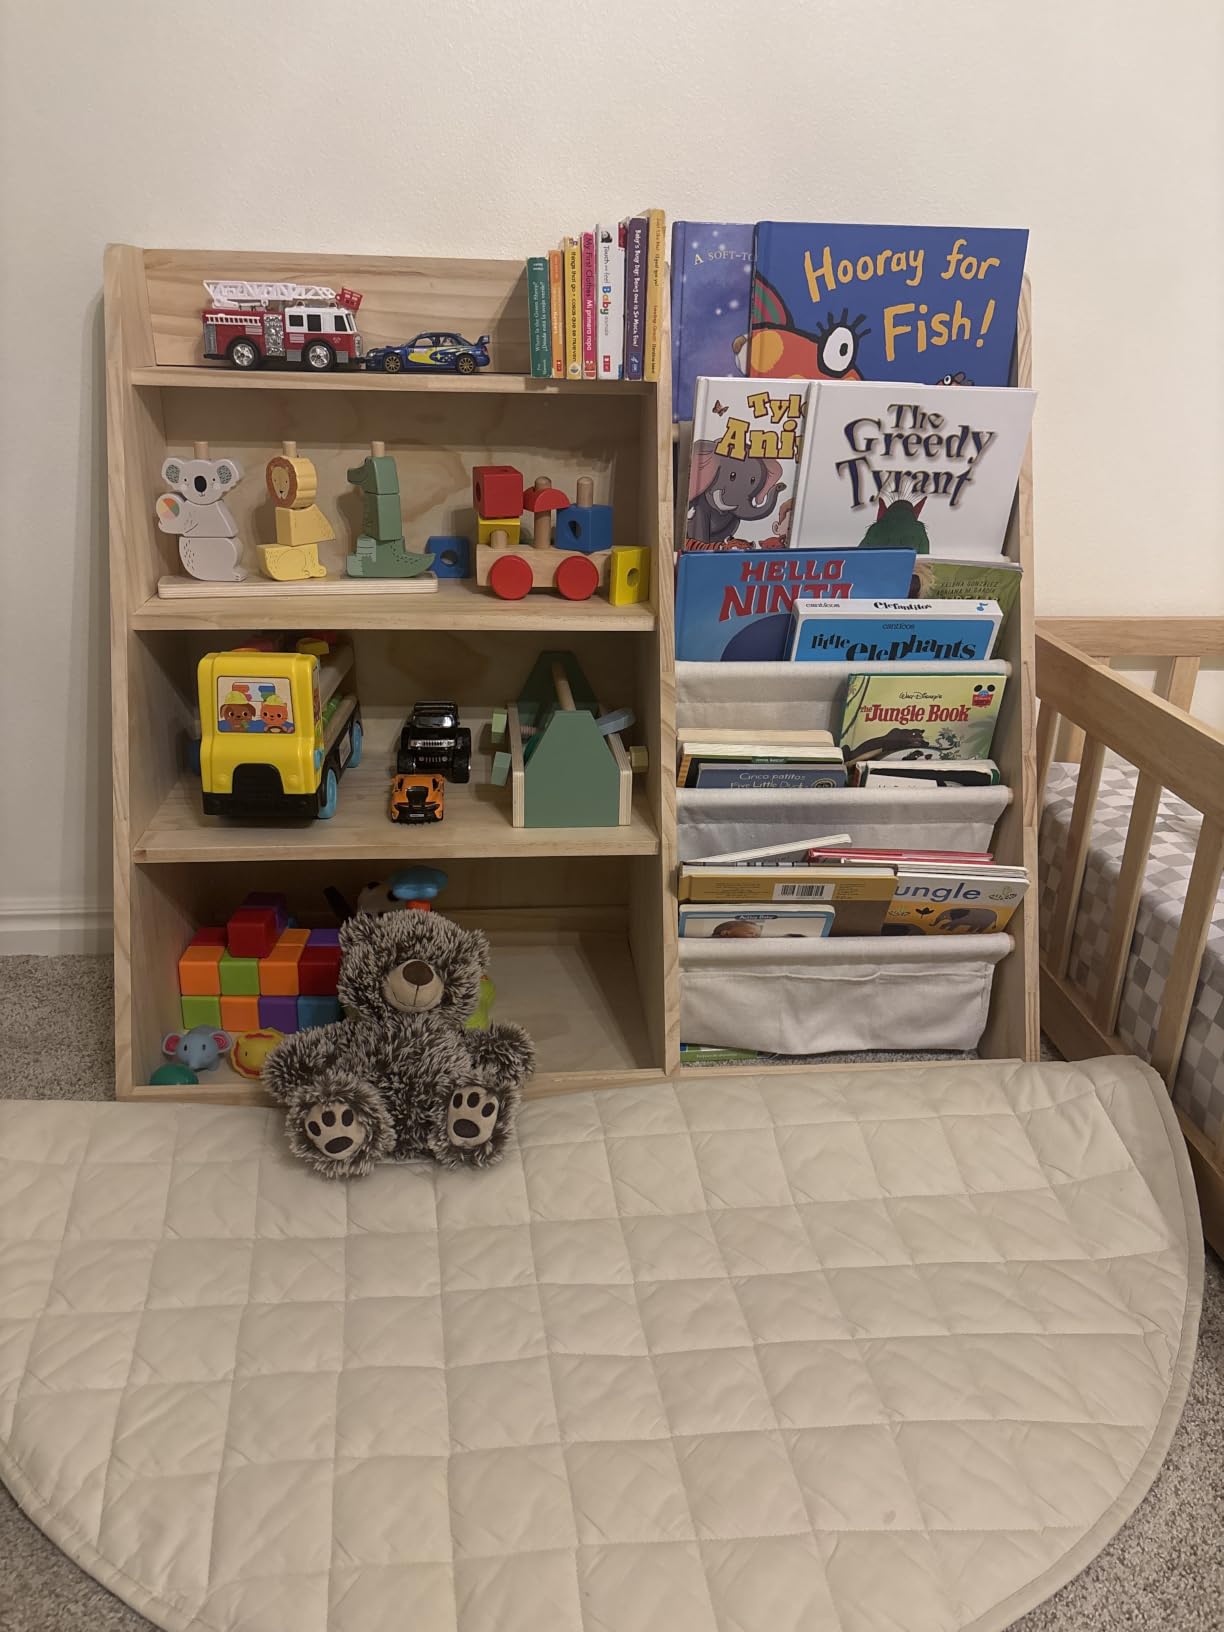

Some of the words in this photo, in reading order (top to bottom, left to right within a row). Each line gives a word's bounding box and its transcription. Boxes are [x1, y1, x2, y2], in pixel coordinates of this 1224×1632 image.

[585, 238, 592, 249] My
[694, 253, 704, 265] A
[803, 246, 924, 302] Hooray
[941, 239, 1000, 281] for
[570, 284, 576, 292] go
[585, 269, 593, 297] Clothes
[632, 277, 640, 292] Being
[586, 300, 593, 309] Mi
[600, 285, 612, 315] Baby
[883, 298, 996, 362] Fish!
[887, 403, 944, 430] The
[714, 416, 803, 463] Ani
[844, 418, 998, 464] Greedy
[835, 456, 974, 509] Tyrant
[740, 559, 846, 582] HELLO
[882, 622, 915, 630] canticos
[811, 633, 850, 650] little
[865, 704, 926, 725] Jungle
[926, 704, 971, 722] Book
[739, 772, 770, 780] Cinco
[771, 773, 806, 784] patitos
[894, 882, 981, 902] ungle
